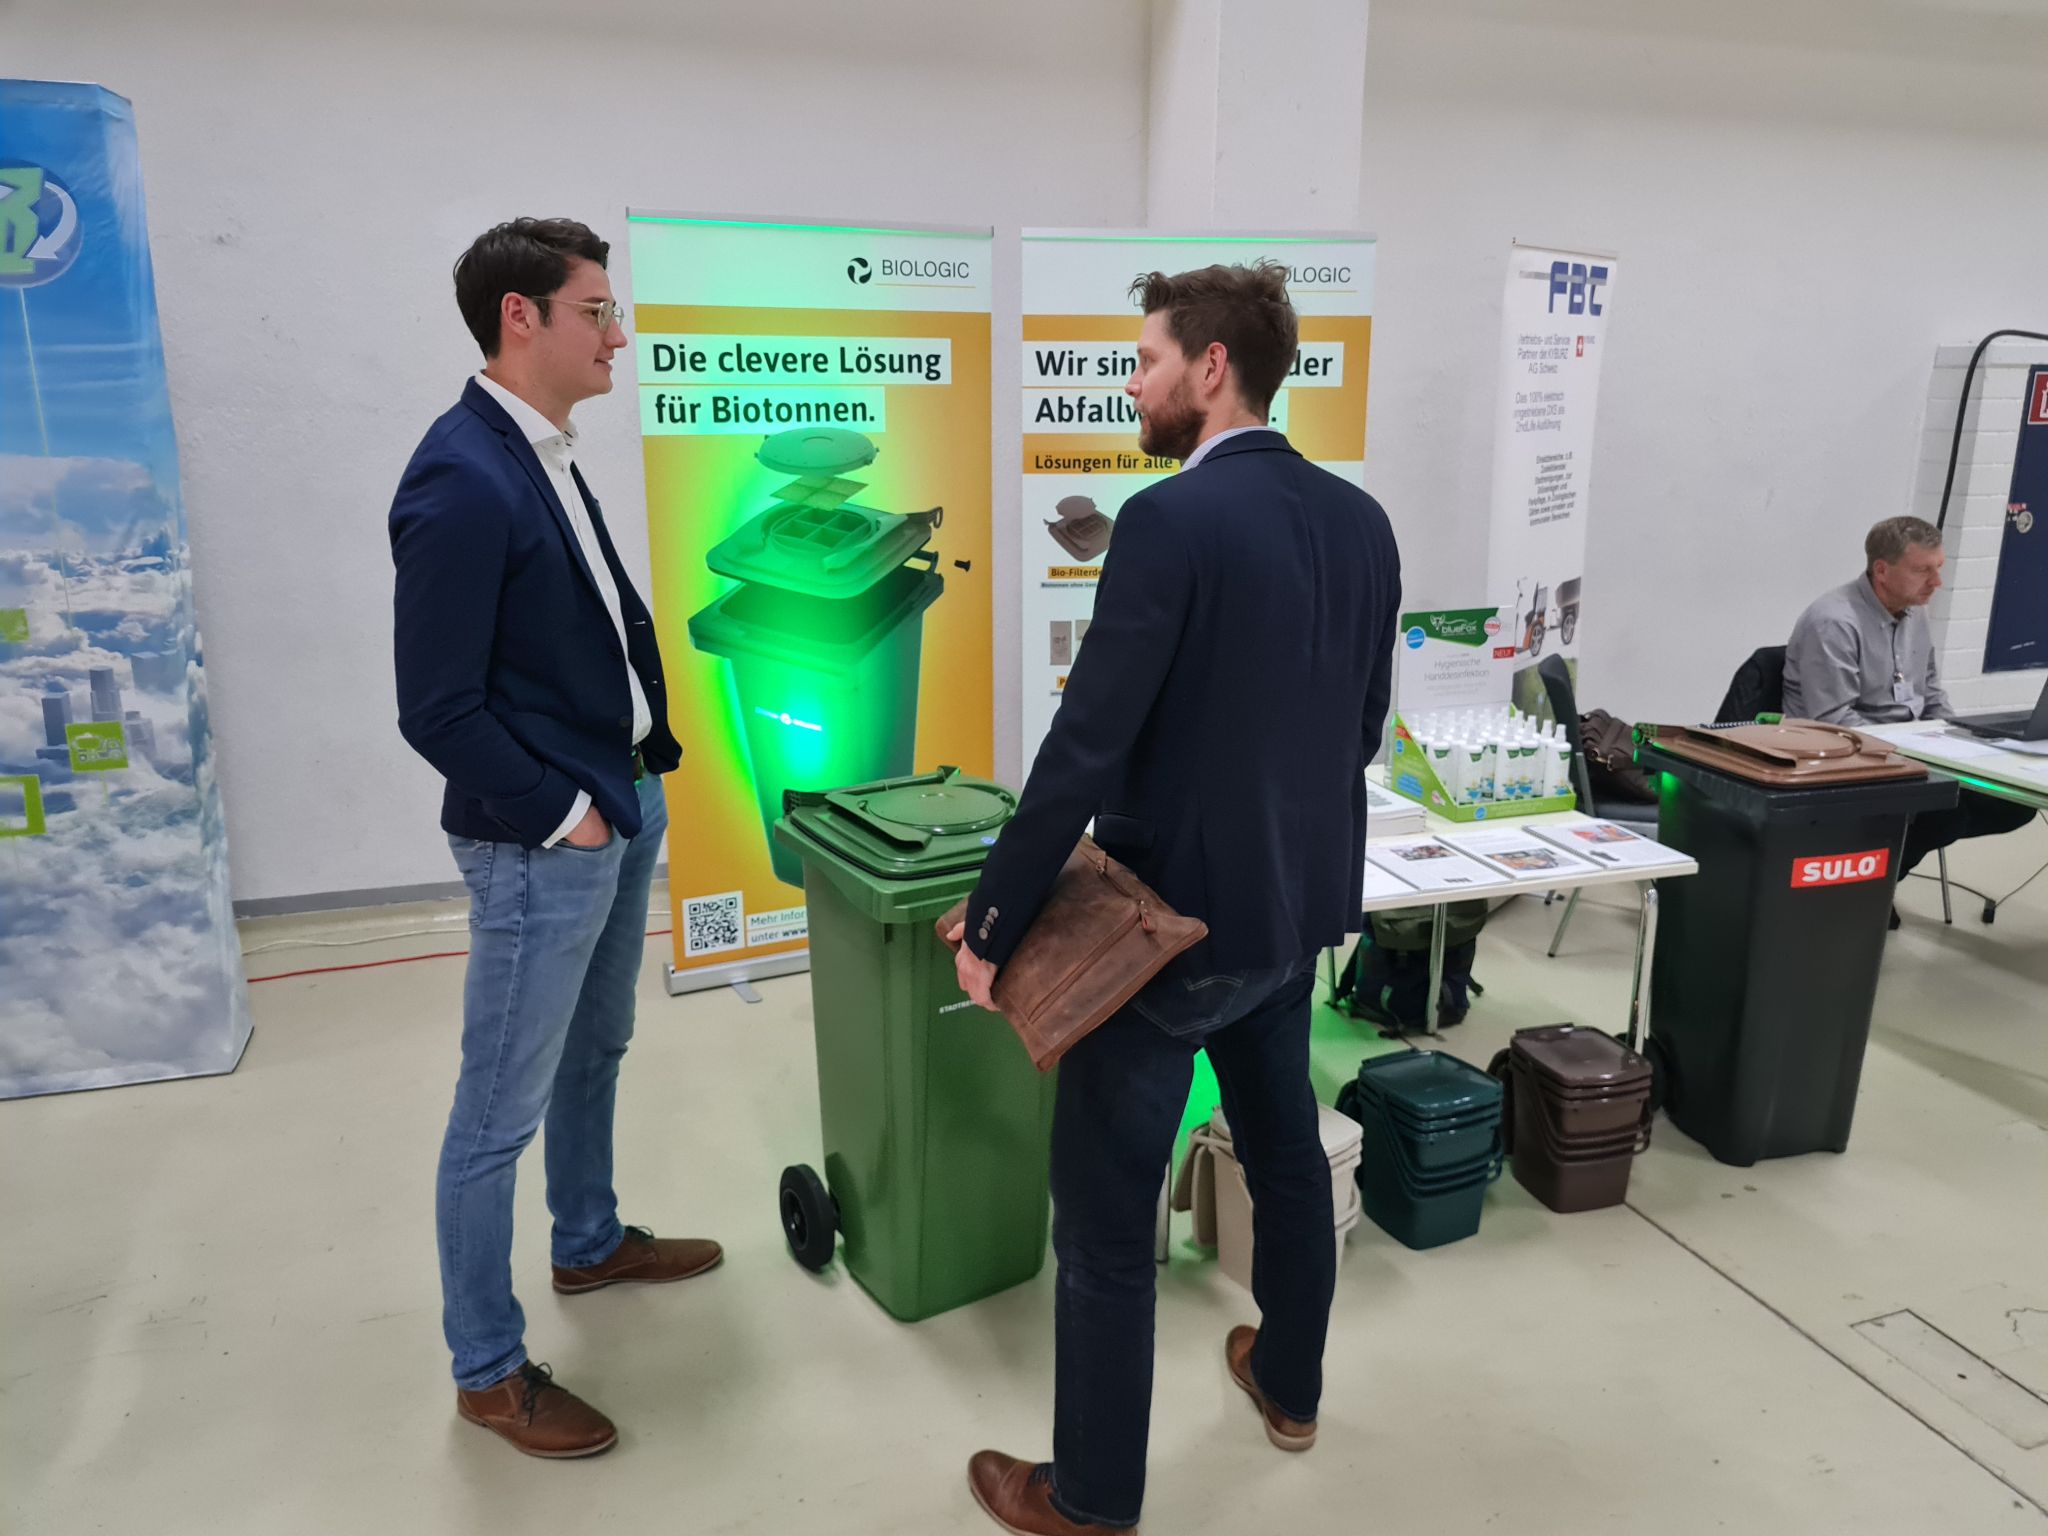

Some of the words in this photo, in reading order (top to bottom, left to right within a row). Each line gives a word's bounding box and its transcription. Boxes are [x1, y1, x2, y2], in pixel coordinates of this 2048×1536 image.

[881, 259, 970, 279] BIOLOGIC
[1286, 267, 1351, 283] LOGIC
[652, 343, 707, 372] Die
[718, 343, 829, 373] clevere
[839, 346, 942, 381] Lösung
[1035, 350, 1087, 376] Wir
[1097, 350, 1137, 376] sin
[655, 394, 701, 424] für
[712, 396, 876, 424] Biotonnen.
[1035, 455, 1111, 473] Lösungen
[1117, 454, 1139, 469] für
[1144, 455, 1173, 469] alle
[1051, 567, 1102, 577] Bio-Filterd
[1802, 856, 1876, 882] SULO
[751, 914, 778, 926] Mehr
[780, 910, 806, 921] Infor
[751, 931, 779, 943] unter
[782, 928, 807, 937] www
